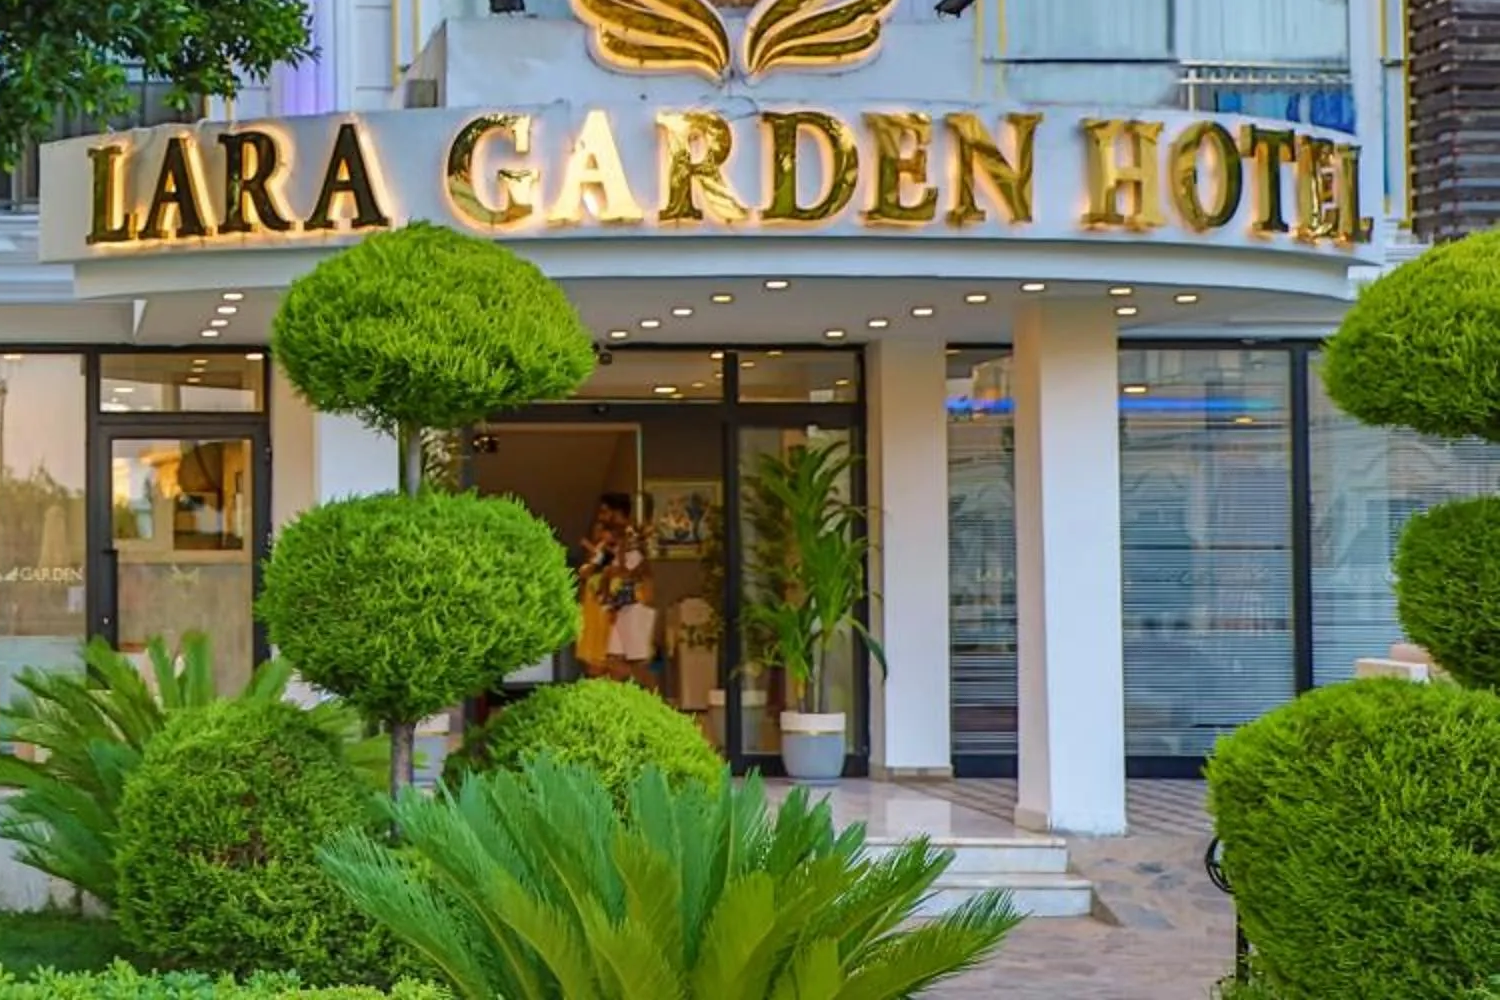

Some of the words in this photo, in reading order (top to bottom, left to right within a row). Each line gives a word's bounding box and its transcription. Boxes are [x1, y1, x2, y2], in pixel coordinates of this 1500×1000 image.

[85, 121, 391, 246] LARA
[447, 108, 1043, 229] GARDEN
[1078, 115, 1375, 248] HOTEL
[19, 566, 84, 581] GARDEN
